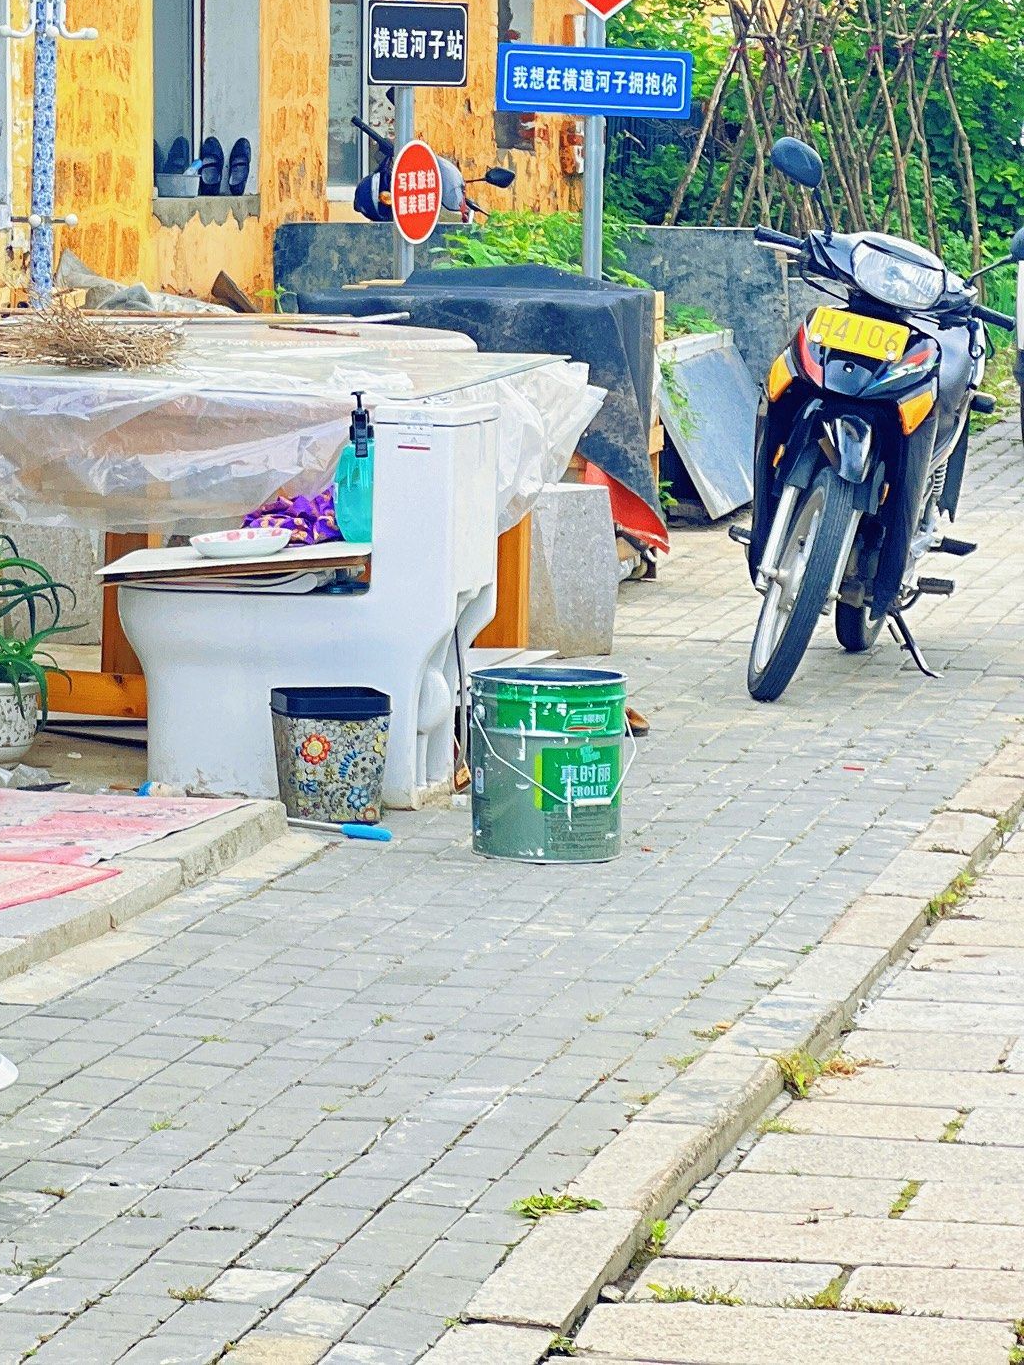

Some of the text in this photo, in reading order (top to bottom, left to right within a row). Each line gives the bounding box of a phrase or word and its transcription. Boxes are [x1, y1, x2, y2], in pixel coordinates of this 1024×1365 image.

[373, 27, 464, 60] 横道河子站
[512, 65, 678, 96] 我想在横道河子拥抱你
[398, 169, 436, 191] 写真旅拍
[398, 192, 436, 215] 服装租赁
[560, 763, 612, 784] 真时丽
